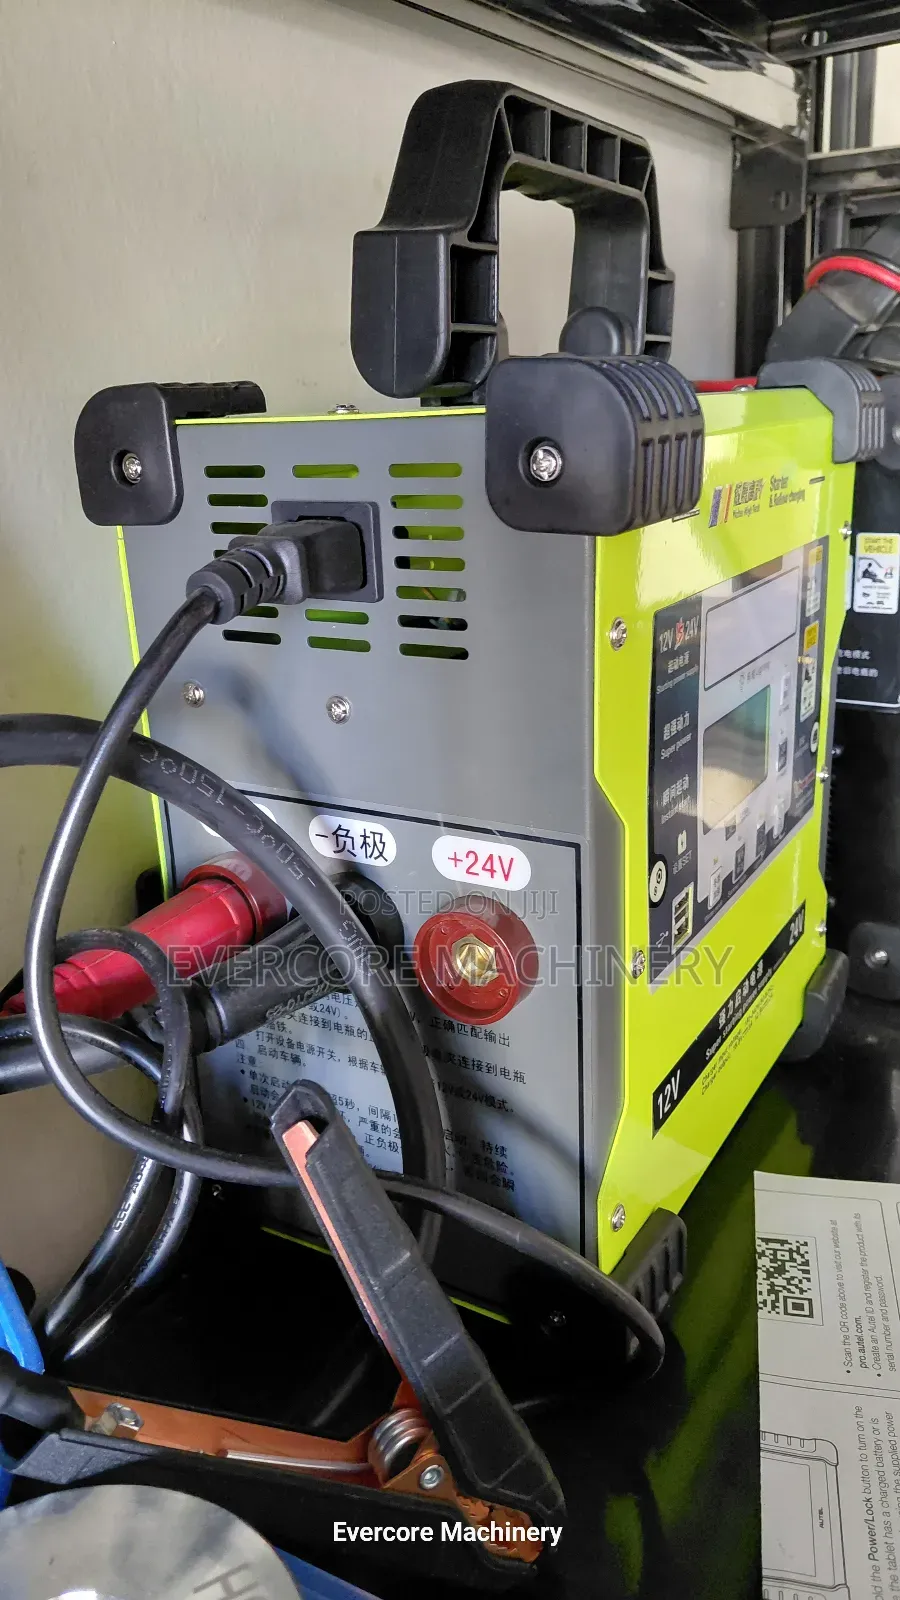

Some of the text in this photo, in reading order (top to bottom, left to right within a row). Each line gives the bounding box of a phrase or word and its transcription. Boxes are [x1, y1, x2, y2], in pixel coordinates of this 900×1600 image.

[660, 615, 700, 654] 12V 24V
[448, 850, 514, 882] +24V
[788, 909, 806, 947] 24V
[657, 1069, 680, 1120] 12V
[853, 1221, 863, 1232] with
[830, 1226, 840, 1248] website
[855, 1234, 868, 1256] product
[834, 1260, 843, 1272] visit
[859, 1257, 868, 1267] the
[860, 1268, 872, 1291] register
[836, 1282, 846, 1301] above
[863, 1293, 873, 1305] and
[838, 1303, 848, 1319] code
[840, 1321, 849, 1333] QR
[866, 1316, 876, 1333] Autel
[874, 1276, 896, 1372] serial number and password.
[841, 1335, 851, 1345] the
[854, 1316, 869, 1369] pro.autel.com.
[870, 1335, 878, 1344] an
[843, 1348, 852, 1367] Scan
[871, 1346, 882, 1370] Create
[853, 1406, 863, 1419] the
[856, 1421, 864, 1431] on
[871, 1426, 880, 1436] or
[885, 1411, 898, 1438] power
[858, 1434, 867, 1450] turn
[858, 1453, 868, 1462] to
[872, 1437, 885, 1468] battery
[887, 1440, 900, 1476] supplied
[861, 1465, 872, 1494] button
[876, 1470, 889, 1508] charged
[862, 1497, 879, 1562] Power/Lock
[882, 1521, 892, 1538] has
[884, 1542, 897, 1571] tablet
[871, 1565, 882, 1582] the
[888, 1575, 900, 1592] the
